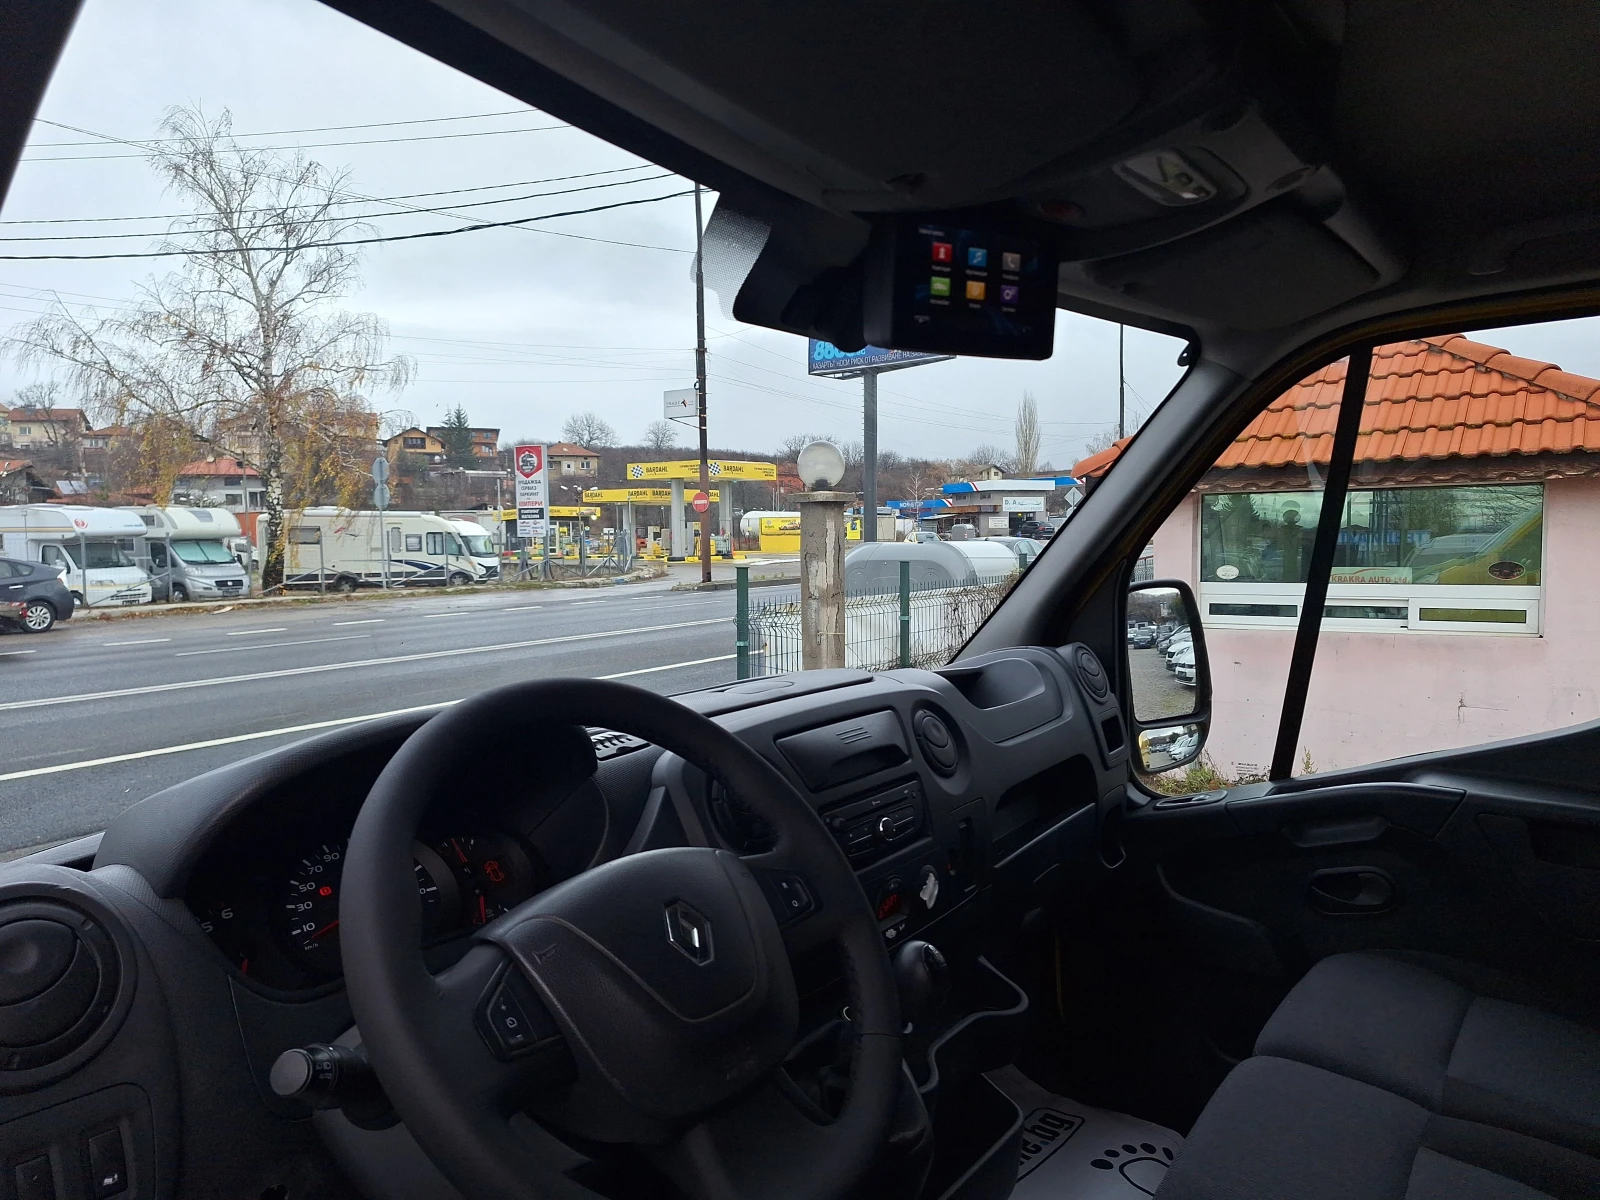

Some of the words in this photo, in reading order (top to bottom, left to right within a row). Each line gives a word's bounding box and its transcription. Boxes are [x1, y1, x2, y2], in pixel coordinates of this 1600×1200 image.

[850, 358, 864, 366] РИСК
[864, 356, 871, 364] ОТ
[723, 465, 745, 473] BARDAHL
[652, 489, 671, 497] BARDAH
[1331, 575, 1366, 583] KRAKRA
[323, 851, 340, 863] 90
[307, 864, 323, 875] 70
[298, 881, 316, 893] 50
[296, 901, 313, 912] 30
[220, 907, 234, 920] 6
[201, 922, 214, 933] 5
[302, 922, 316, 933] 10
